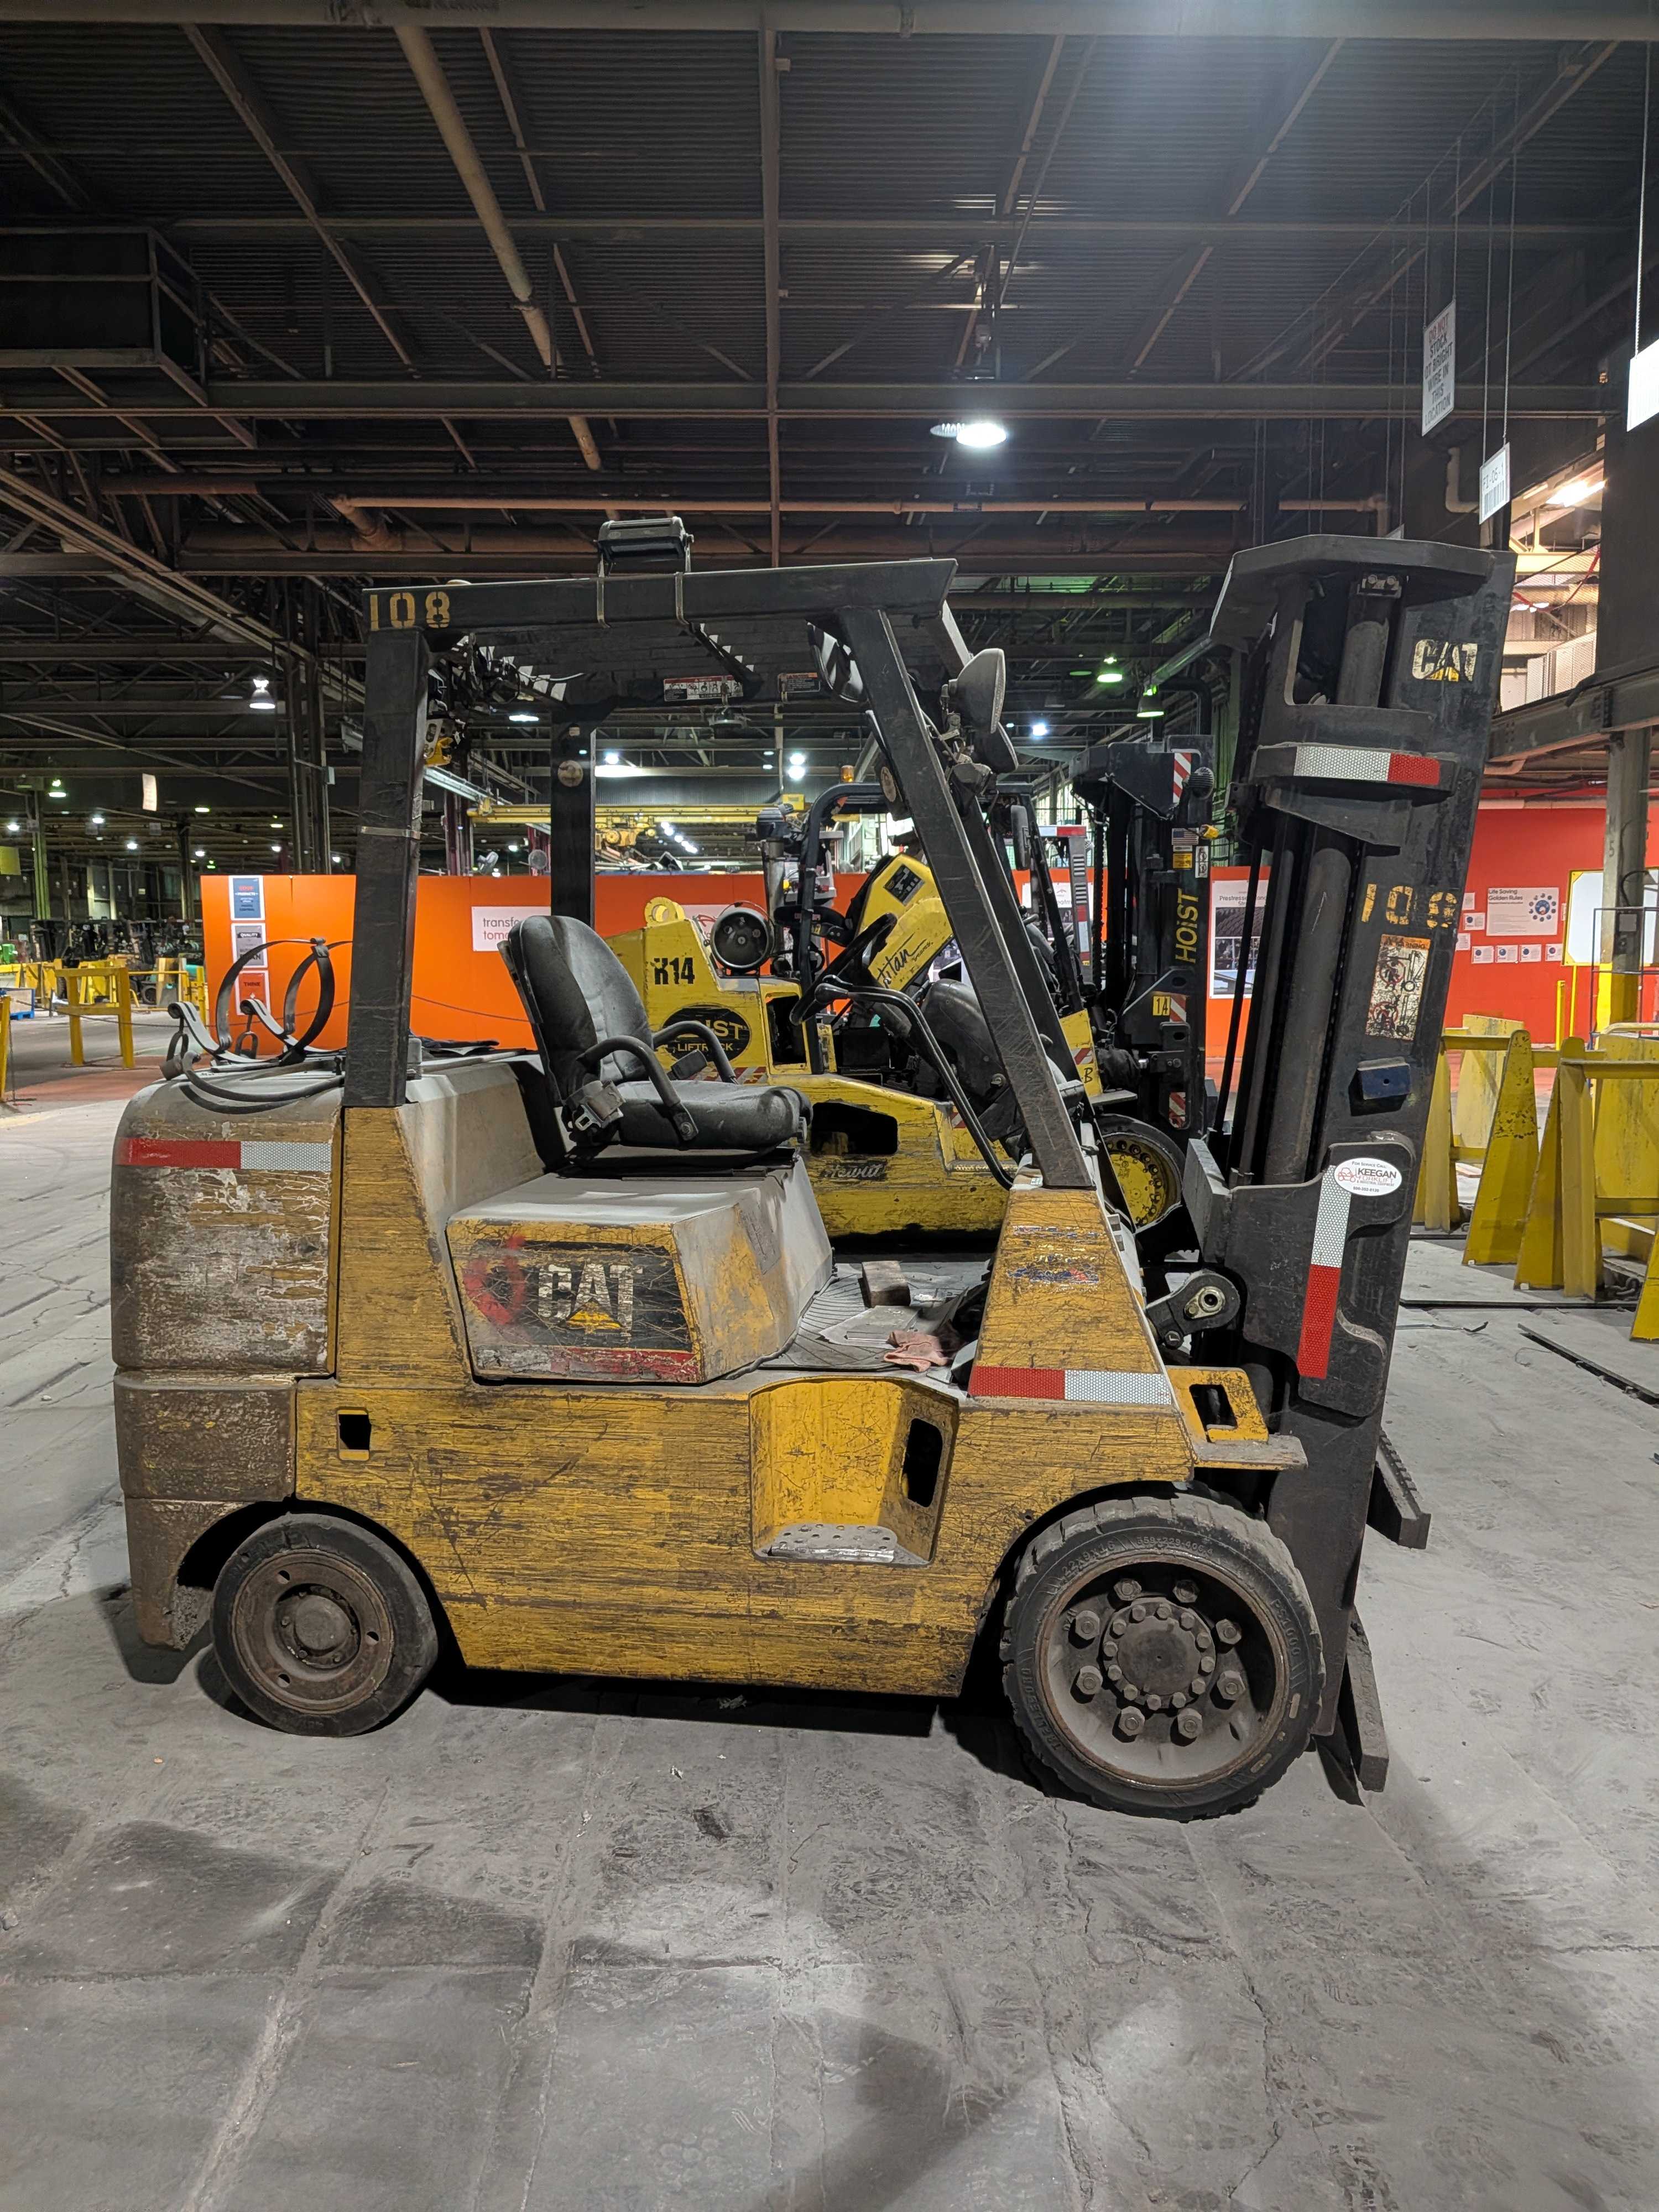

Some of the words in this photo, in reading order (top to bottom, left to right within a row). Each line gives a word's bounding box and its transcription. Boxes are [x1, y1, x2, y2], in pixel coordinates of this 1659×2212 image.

[1429, 324, 1436, 343] DO
[1438, 311, 1448, 335] NOT
[1430, 329, 1447, 359] STOCK
[1433, 341, 1452, 372] BRIGHT
[1425, 392, 1450, 427] LOCATION
[1432, 382, 1443, 405] THIS
[370, 592, 450, 630] 108
[1412, 639, 1478, 681] CAT
[1609, 841, 1615, 857] 5
[1361, 884, 1457, 928] 108
[1358, 1168, 1397, 1178] KEEGAN
[538, 1264, 643, 1335] CAT
